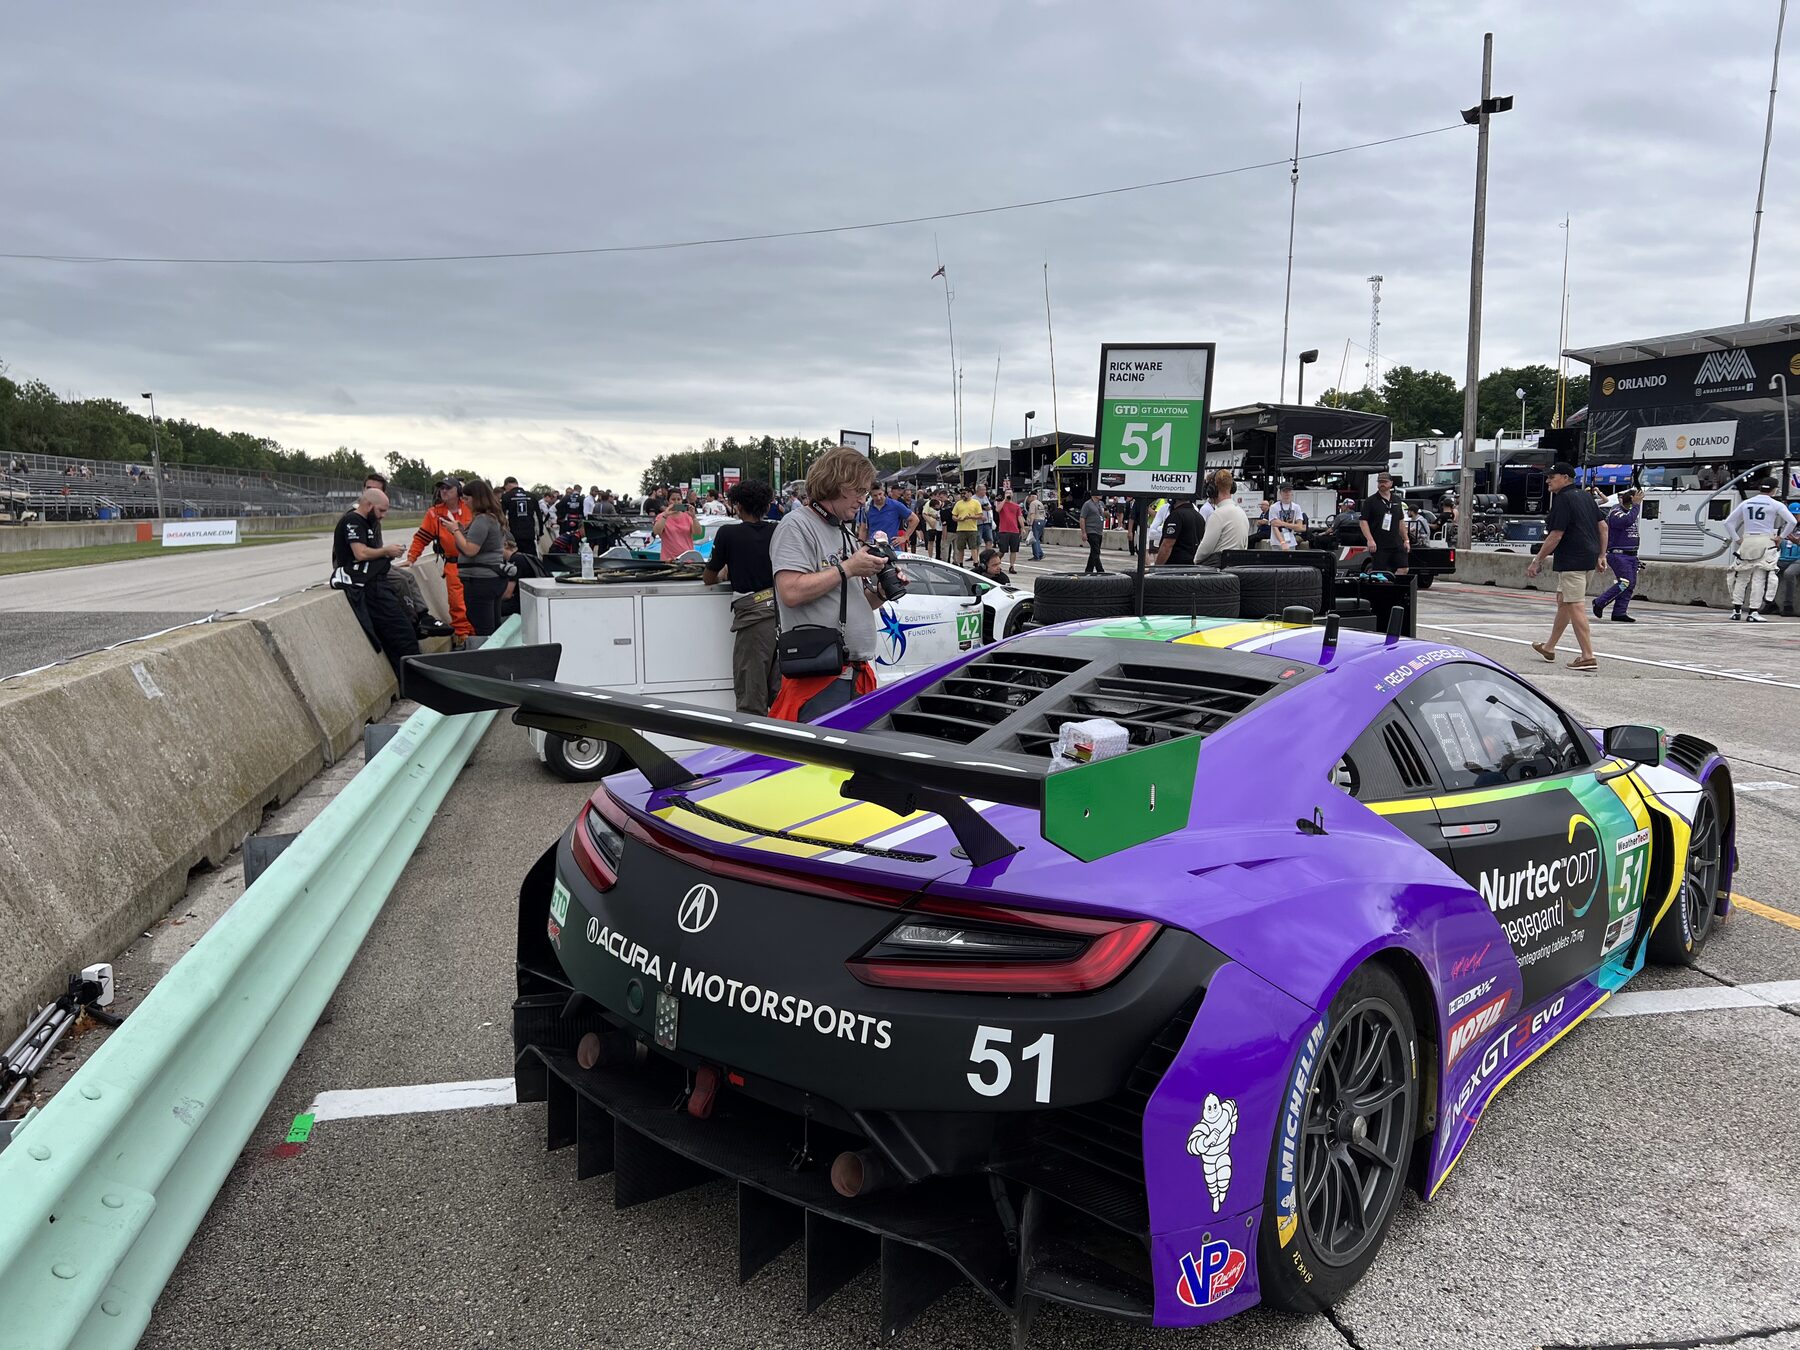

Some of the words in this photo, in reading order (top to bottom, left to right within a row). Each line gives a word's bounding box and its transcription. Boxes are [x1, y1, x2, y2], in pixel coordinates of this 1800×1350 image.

[1110, 361, 1132, 371] RICK
[1135, 361, 1163, 371] WARE
[1109, 373, 1145, 382] RACING
[1617, 374, 1667, 391] ORLANDO
[1115, 405, 1138, 415] GTD
[1153, 407, 1188, 415] DAYTONA
[1119, 422, 1172, 467] 51
[1318, 438, 1374, 448] ANDRETTI
[1689, 435, 1730, 447] ORLANDO
[1072, 452, 1086, 464] 36
[1151, 473, 1193, 483] HAGERTY
[1151, 484, 1185, 492] Motorsports
[812, 502, 828, 517] Canon
[1747, 506, 1766, 520] 16
[904, 613, 942, 623] SOUTHWEST
[961, 615, 980, 639] 42
[908, 629, 937, 637] FUNDING
[1384, 665, 1413, 687] READ
[1416, 650, 1468, 666] EVERSLEY
[1617, 832, 1649, 852] WeatherTech
[1566, 848, 1598, 888] ODT
[1617, 849, 1644, 913] 51
[596, 926, 662, 982] ACURA
[681, 967, 893, 1049] MOTORSPORTS
[1531, 997, 1565, 1035] EVO
[1448, 998, 1506, 1067] MOTUL
[966, 1024, 1055, 1104] 51
[1281, 1020, 1325, 1183] MICHELIN
[1180, 1241, 1230, 1305] VP
[1213, 1260, 1246, 1292] Racing
